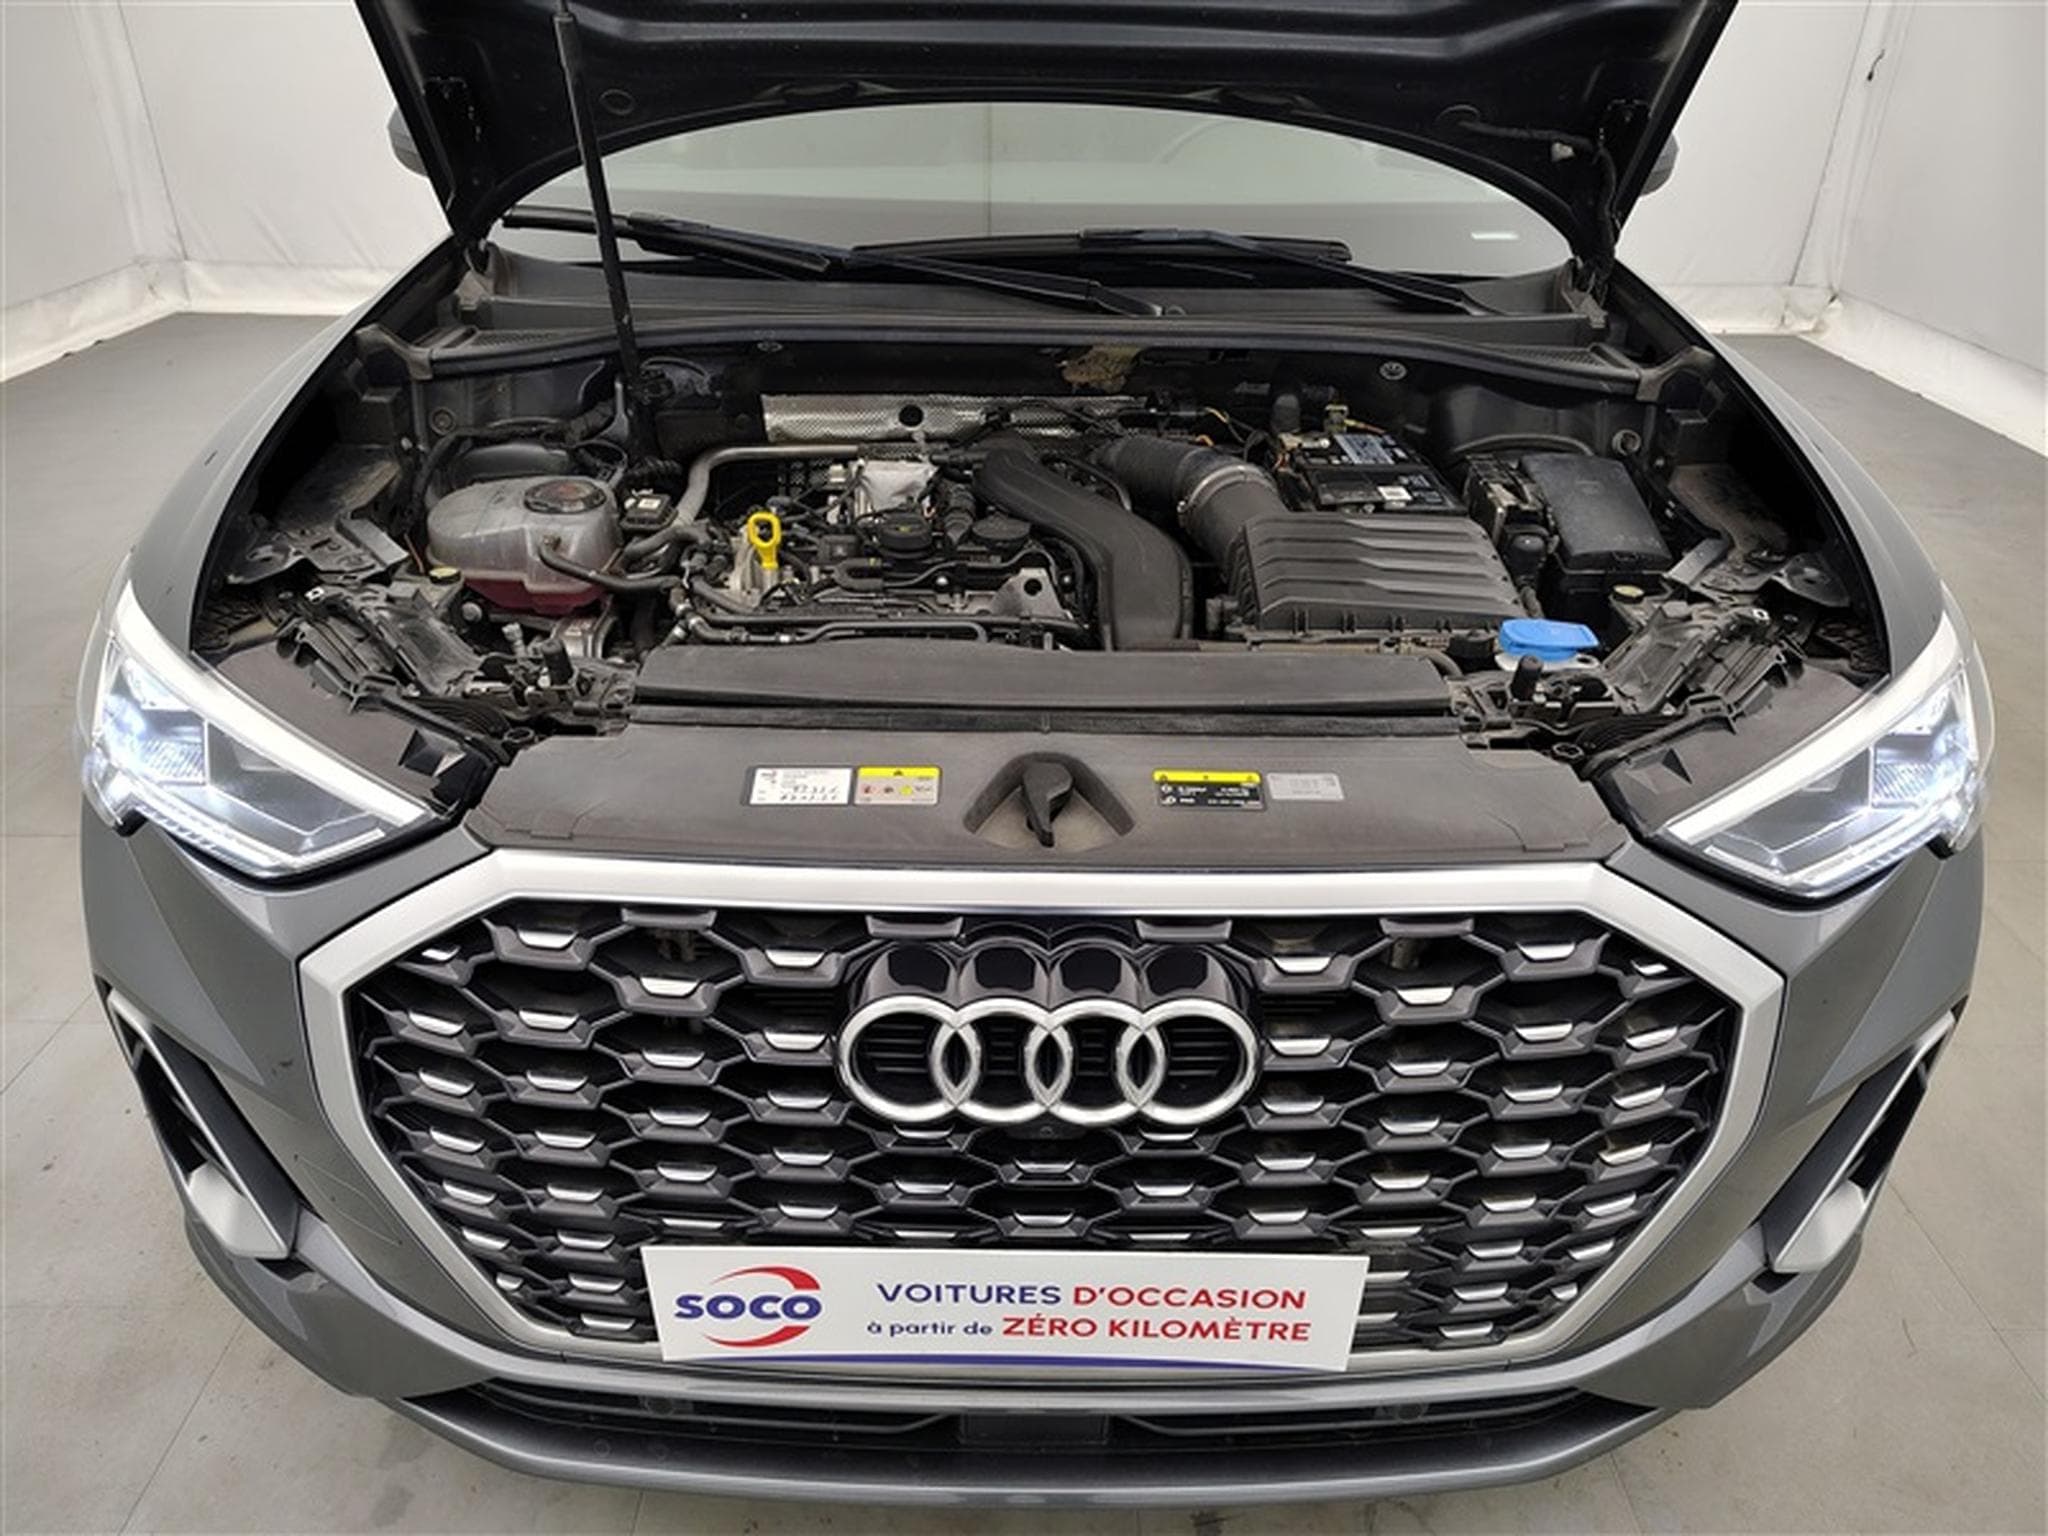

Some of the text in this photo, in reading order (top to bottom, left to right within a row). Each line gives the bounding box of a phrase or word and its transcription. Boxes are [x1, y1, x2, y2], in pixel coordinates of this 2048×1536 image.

[674, 1294, 822, 1319] SOCO
[876, 1282, 1308, 1311] VOITURES D'OCCASION
[866, 1313, 1310, 1342] à partir de ZÉRO KILOMÈTRE
